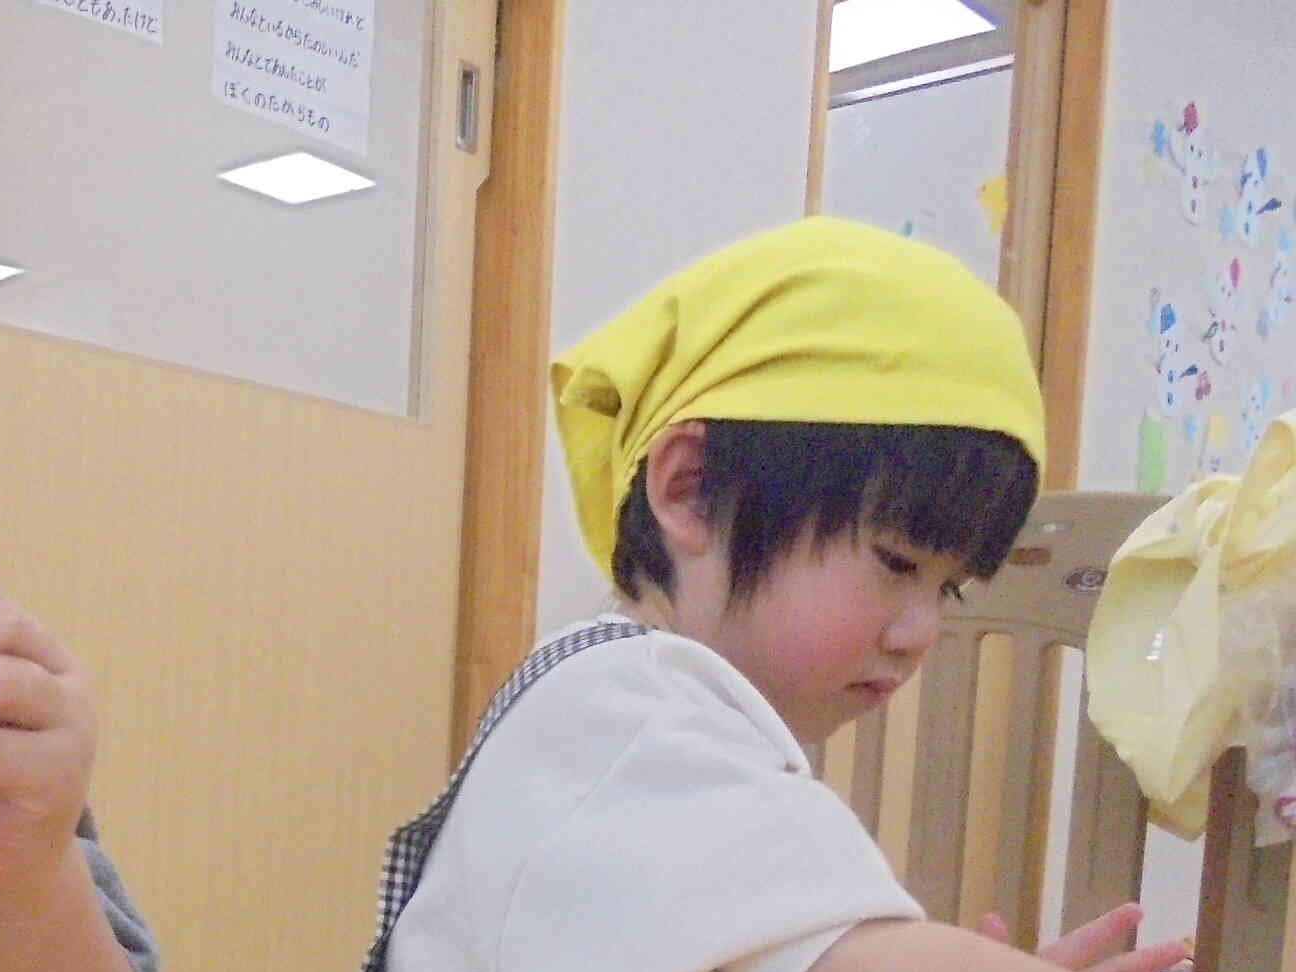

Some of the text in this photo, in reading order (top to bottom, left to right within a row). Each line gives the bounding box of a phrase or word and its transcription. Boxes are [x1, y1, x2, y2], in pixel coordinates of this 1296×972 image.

[224, 81, 330, 132] ぼくのたからもの
